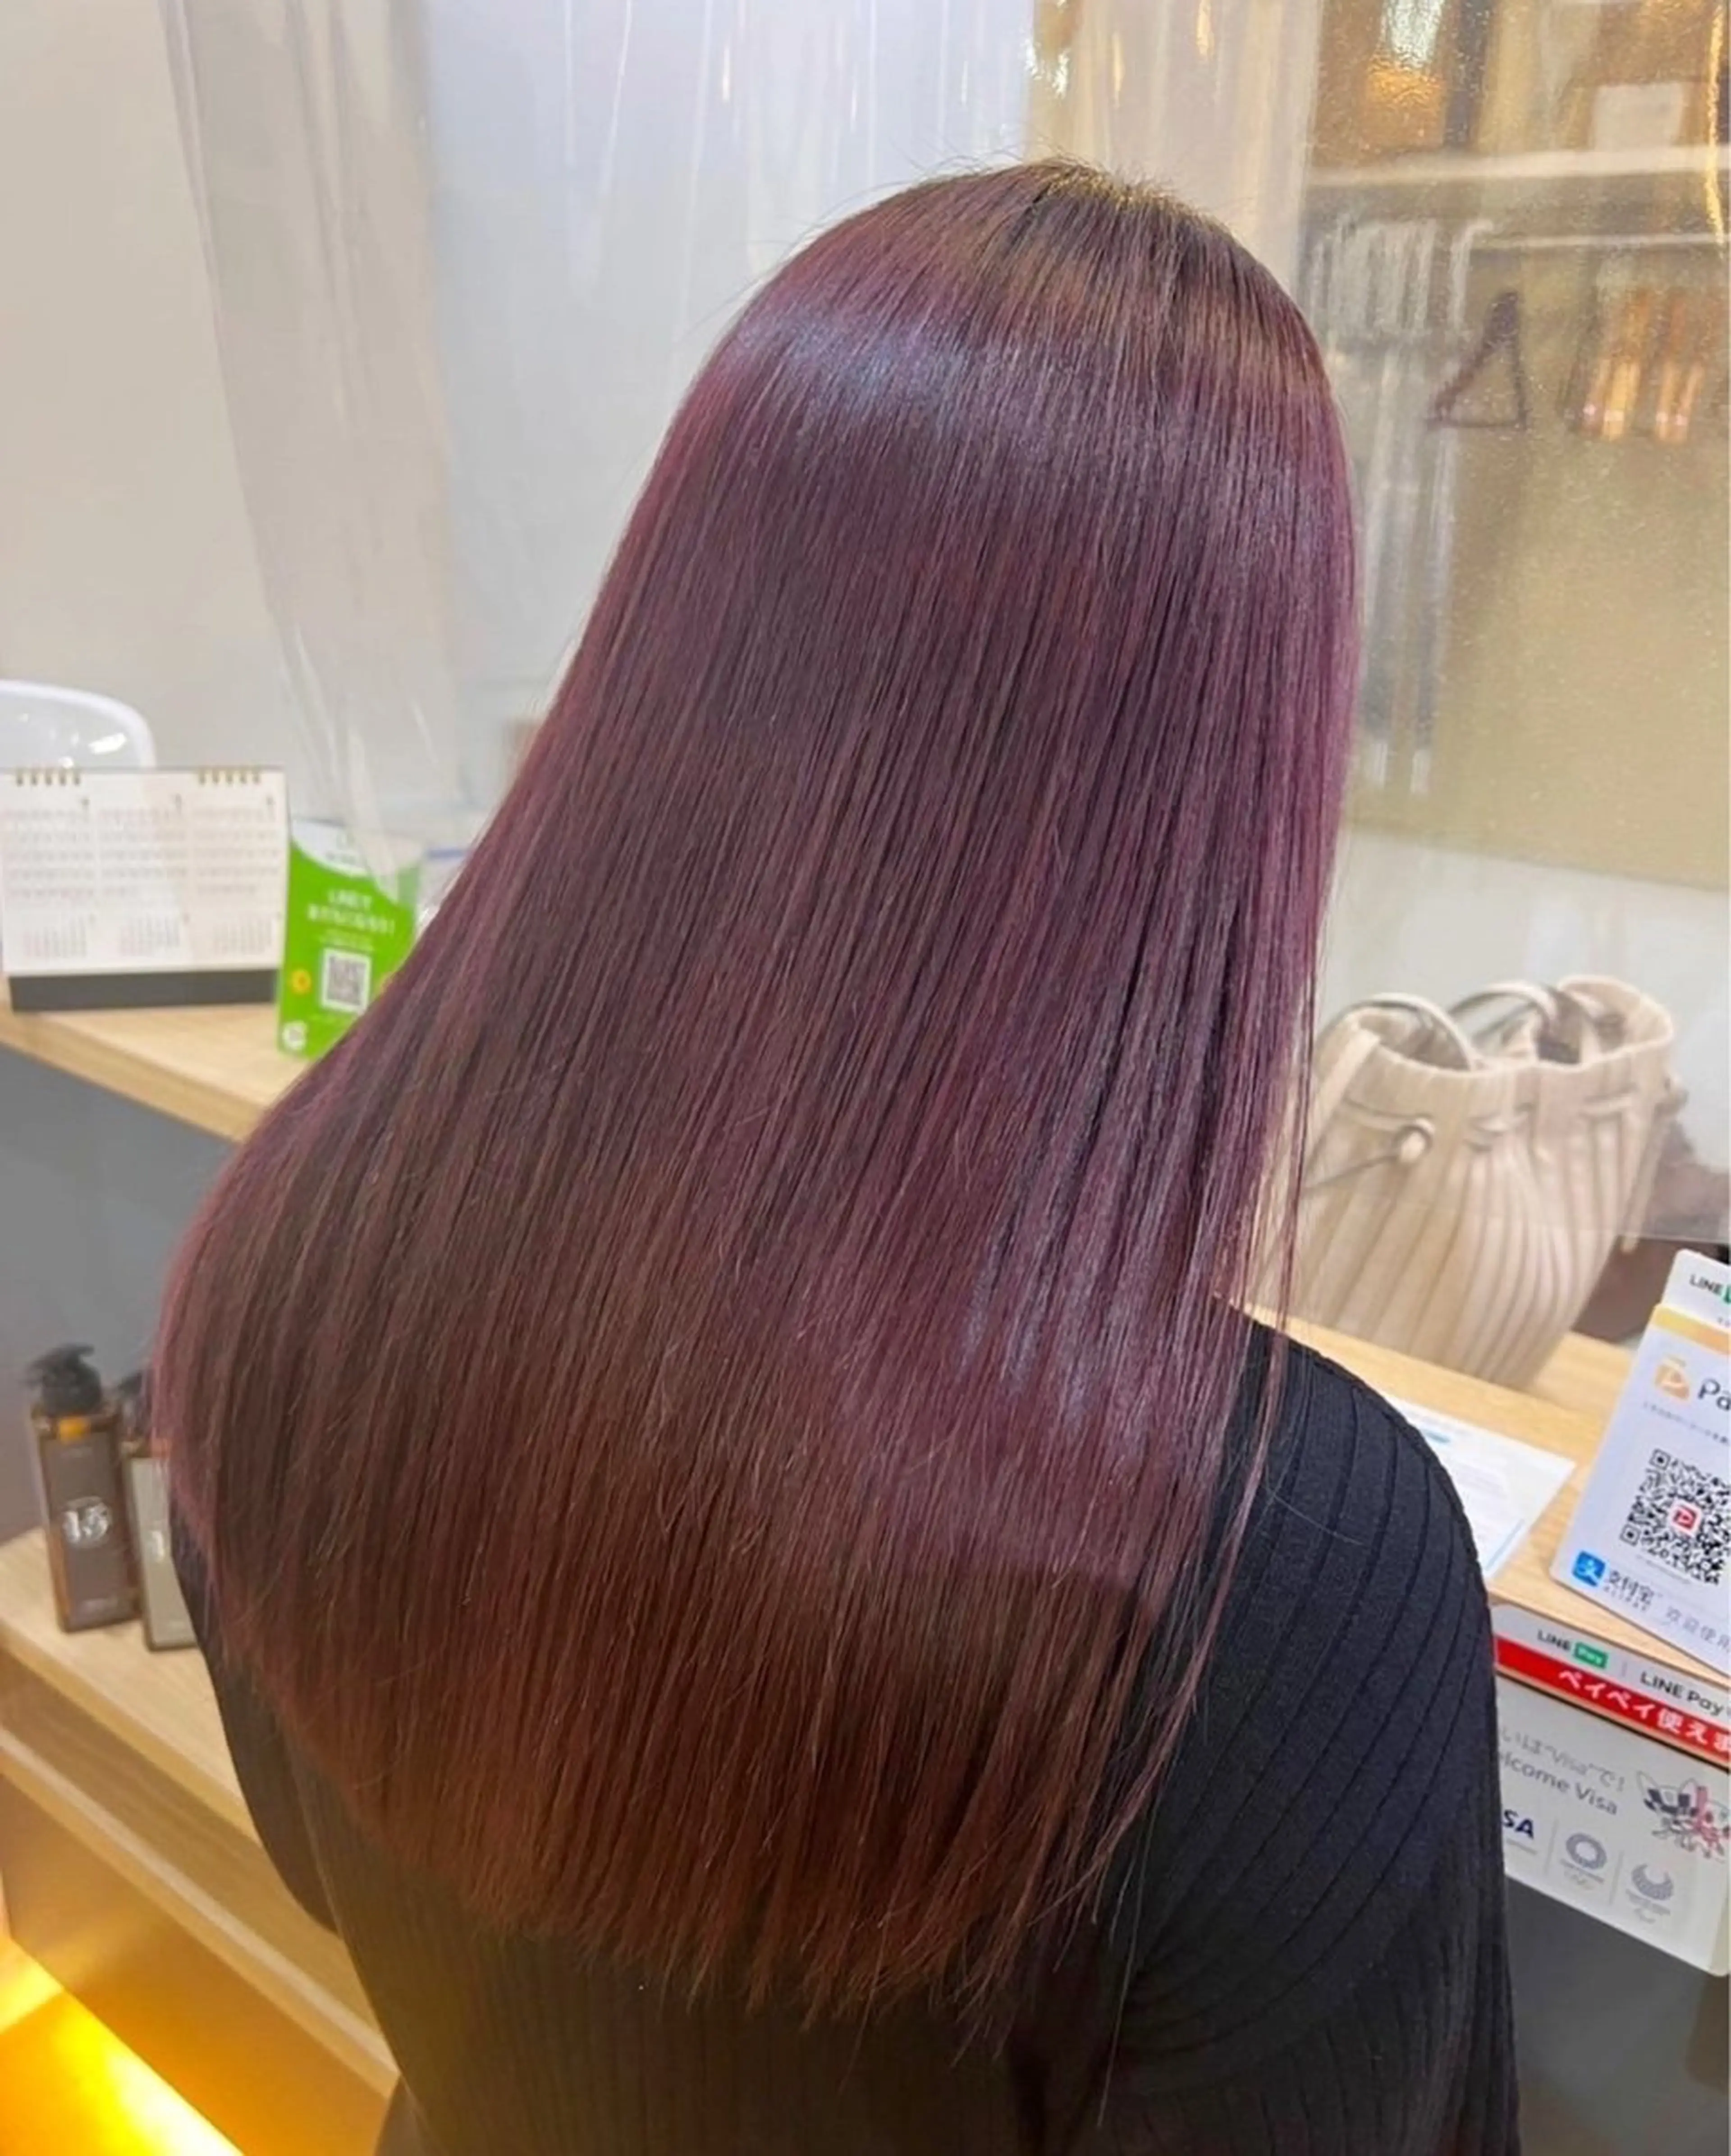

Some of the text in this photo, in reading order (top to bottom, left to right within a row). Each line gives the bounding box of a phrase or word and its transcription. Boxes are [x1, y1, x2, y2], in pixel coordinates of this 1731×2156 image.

[1689, 1273, 1724, 1296] LINE
[1537, 1629, 1571, 1651] LINE
[1640, 1671, 1724, 1716] LINE Pay
[1575, 1782, 1617, 1816] Visa
